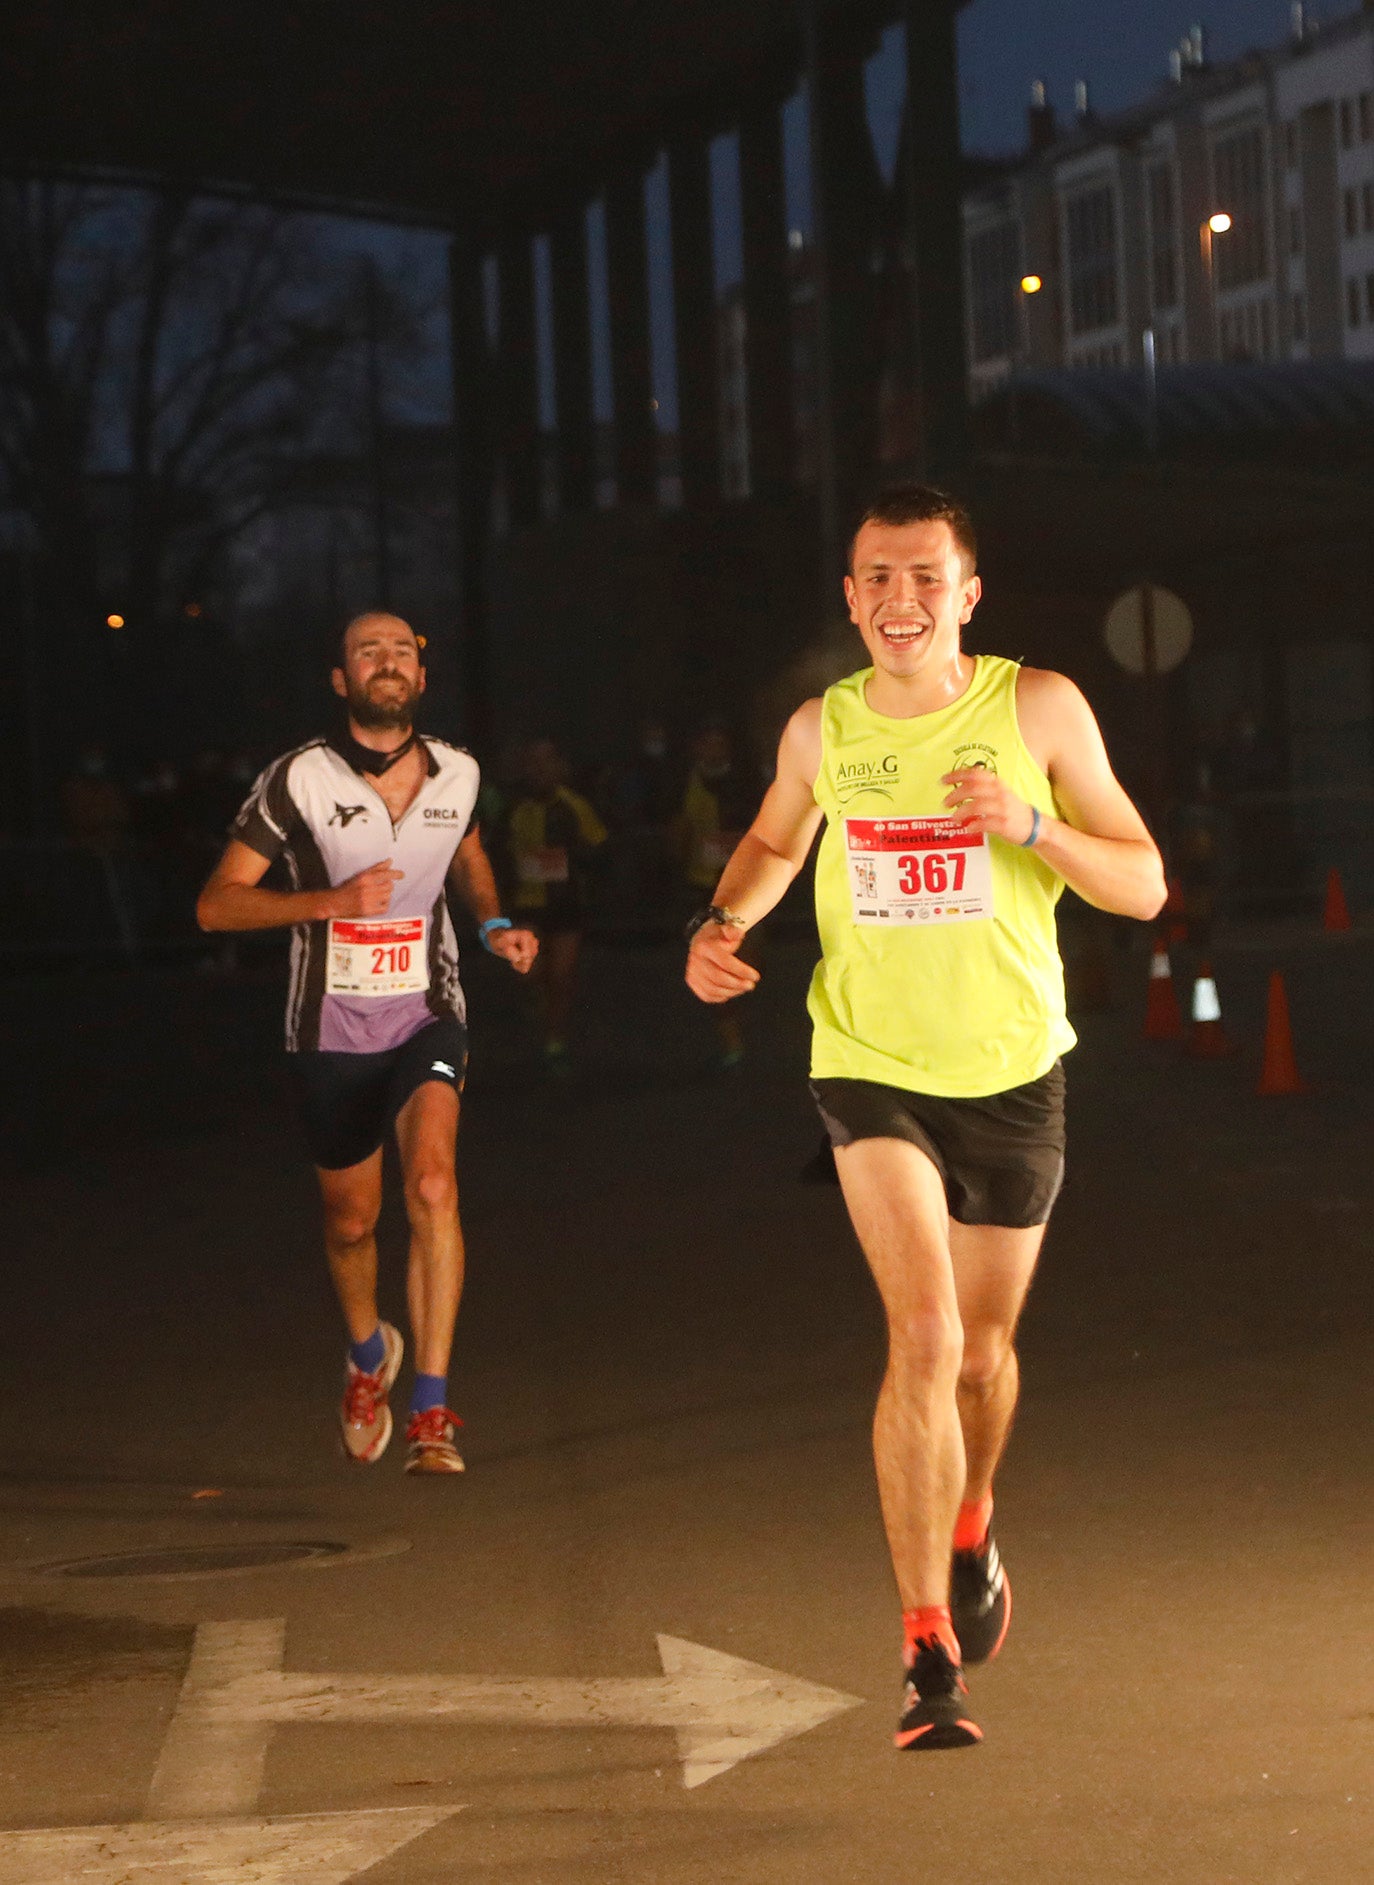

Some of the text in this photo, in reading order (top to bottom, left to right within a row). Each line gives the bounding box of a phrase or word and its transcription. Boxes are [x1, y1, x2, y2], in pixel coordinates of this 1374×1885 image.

[423, 809, 459, 819] ORCA
[887, 821, 909, 830] San
[934, 826, 968, 838] Popul
[897, 852, 966, 895] 367
[371, 945, 411, 974] 210
